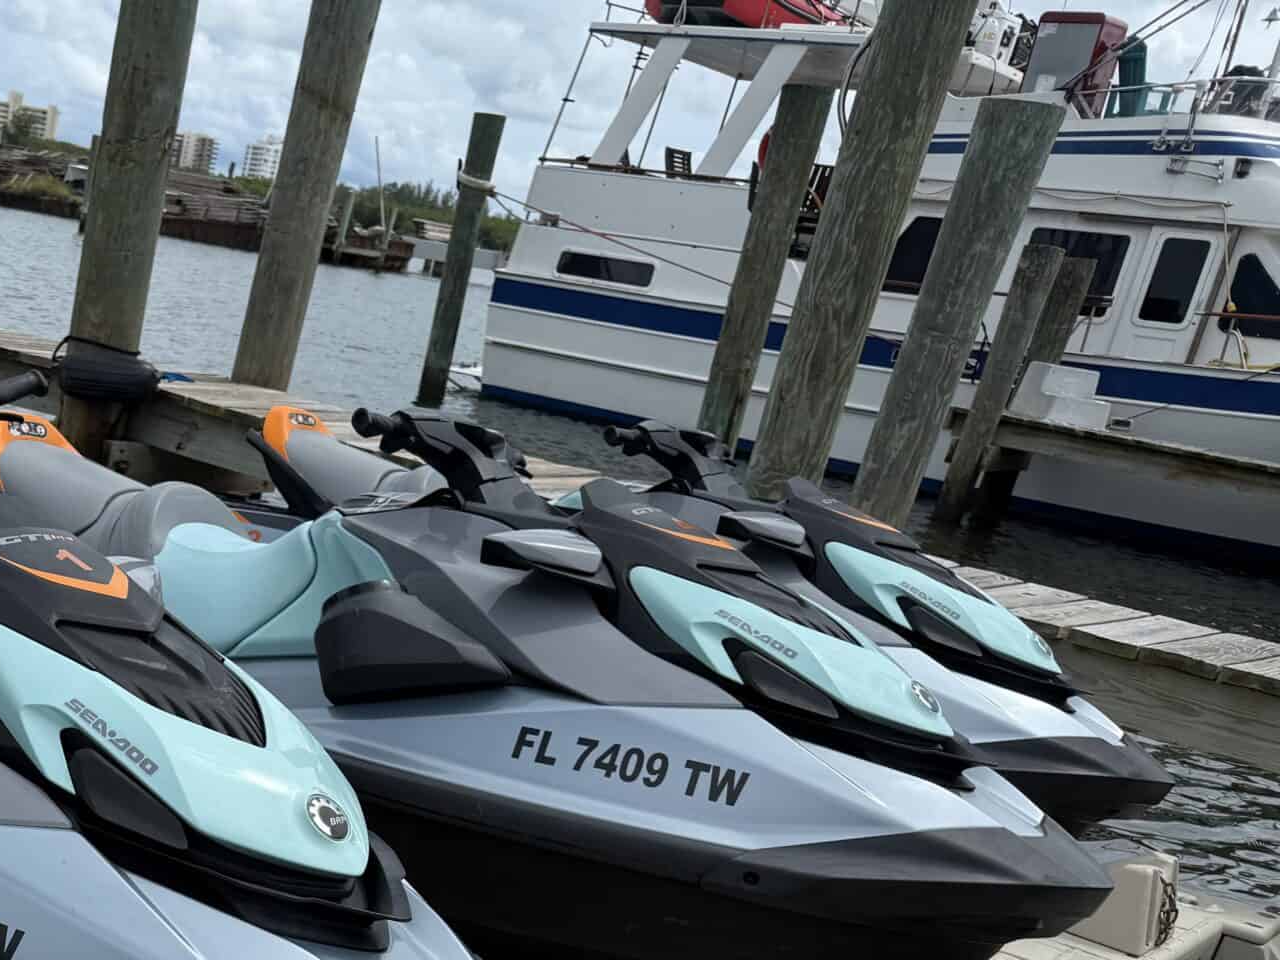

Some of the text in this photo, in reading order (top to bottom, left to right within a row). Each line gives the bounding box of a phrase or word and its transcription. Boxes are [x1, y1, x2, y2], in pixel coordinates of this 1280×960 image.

[55, 549, 94, 572] 1
[511, 726, 750, 806] FL 7409 TW
